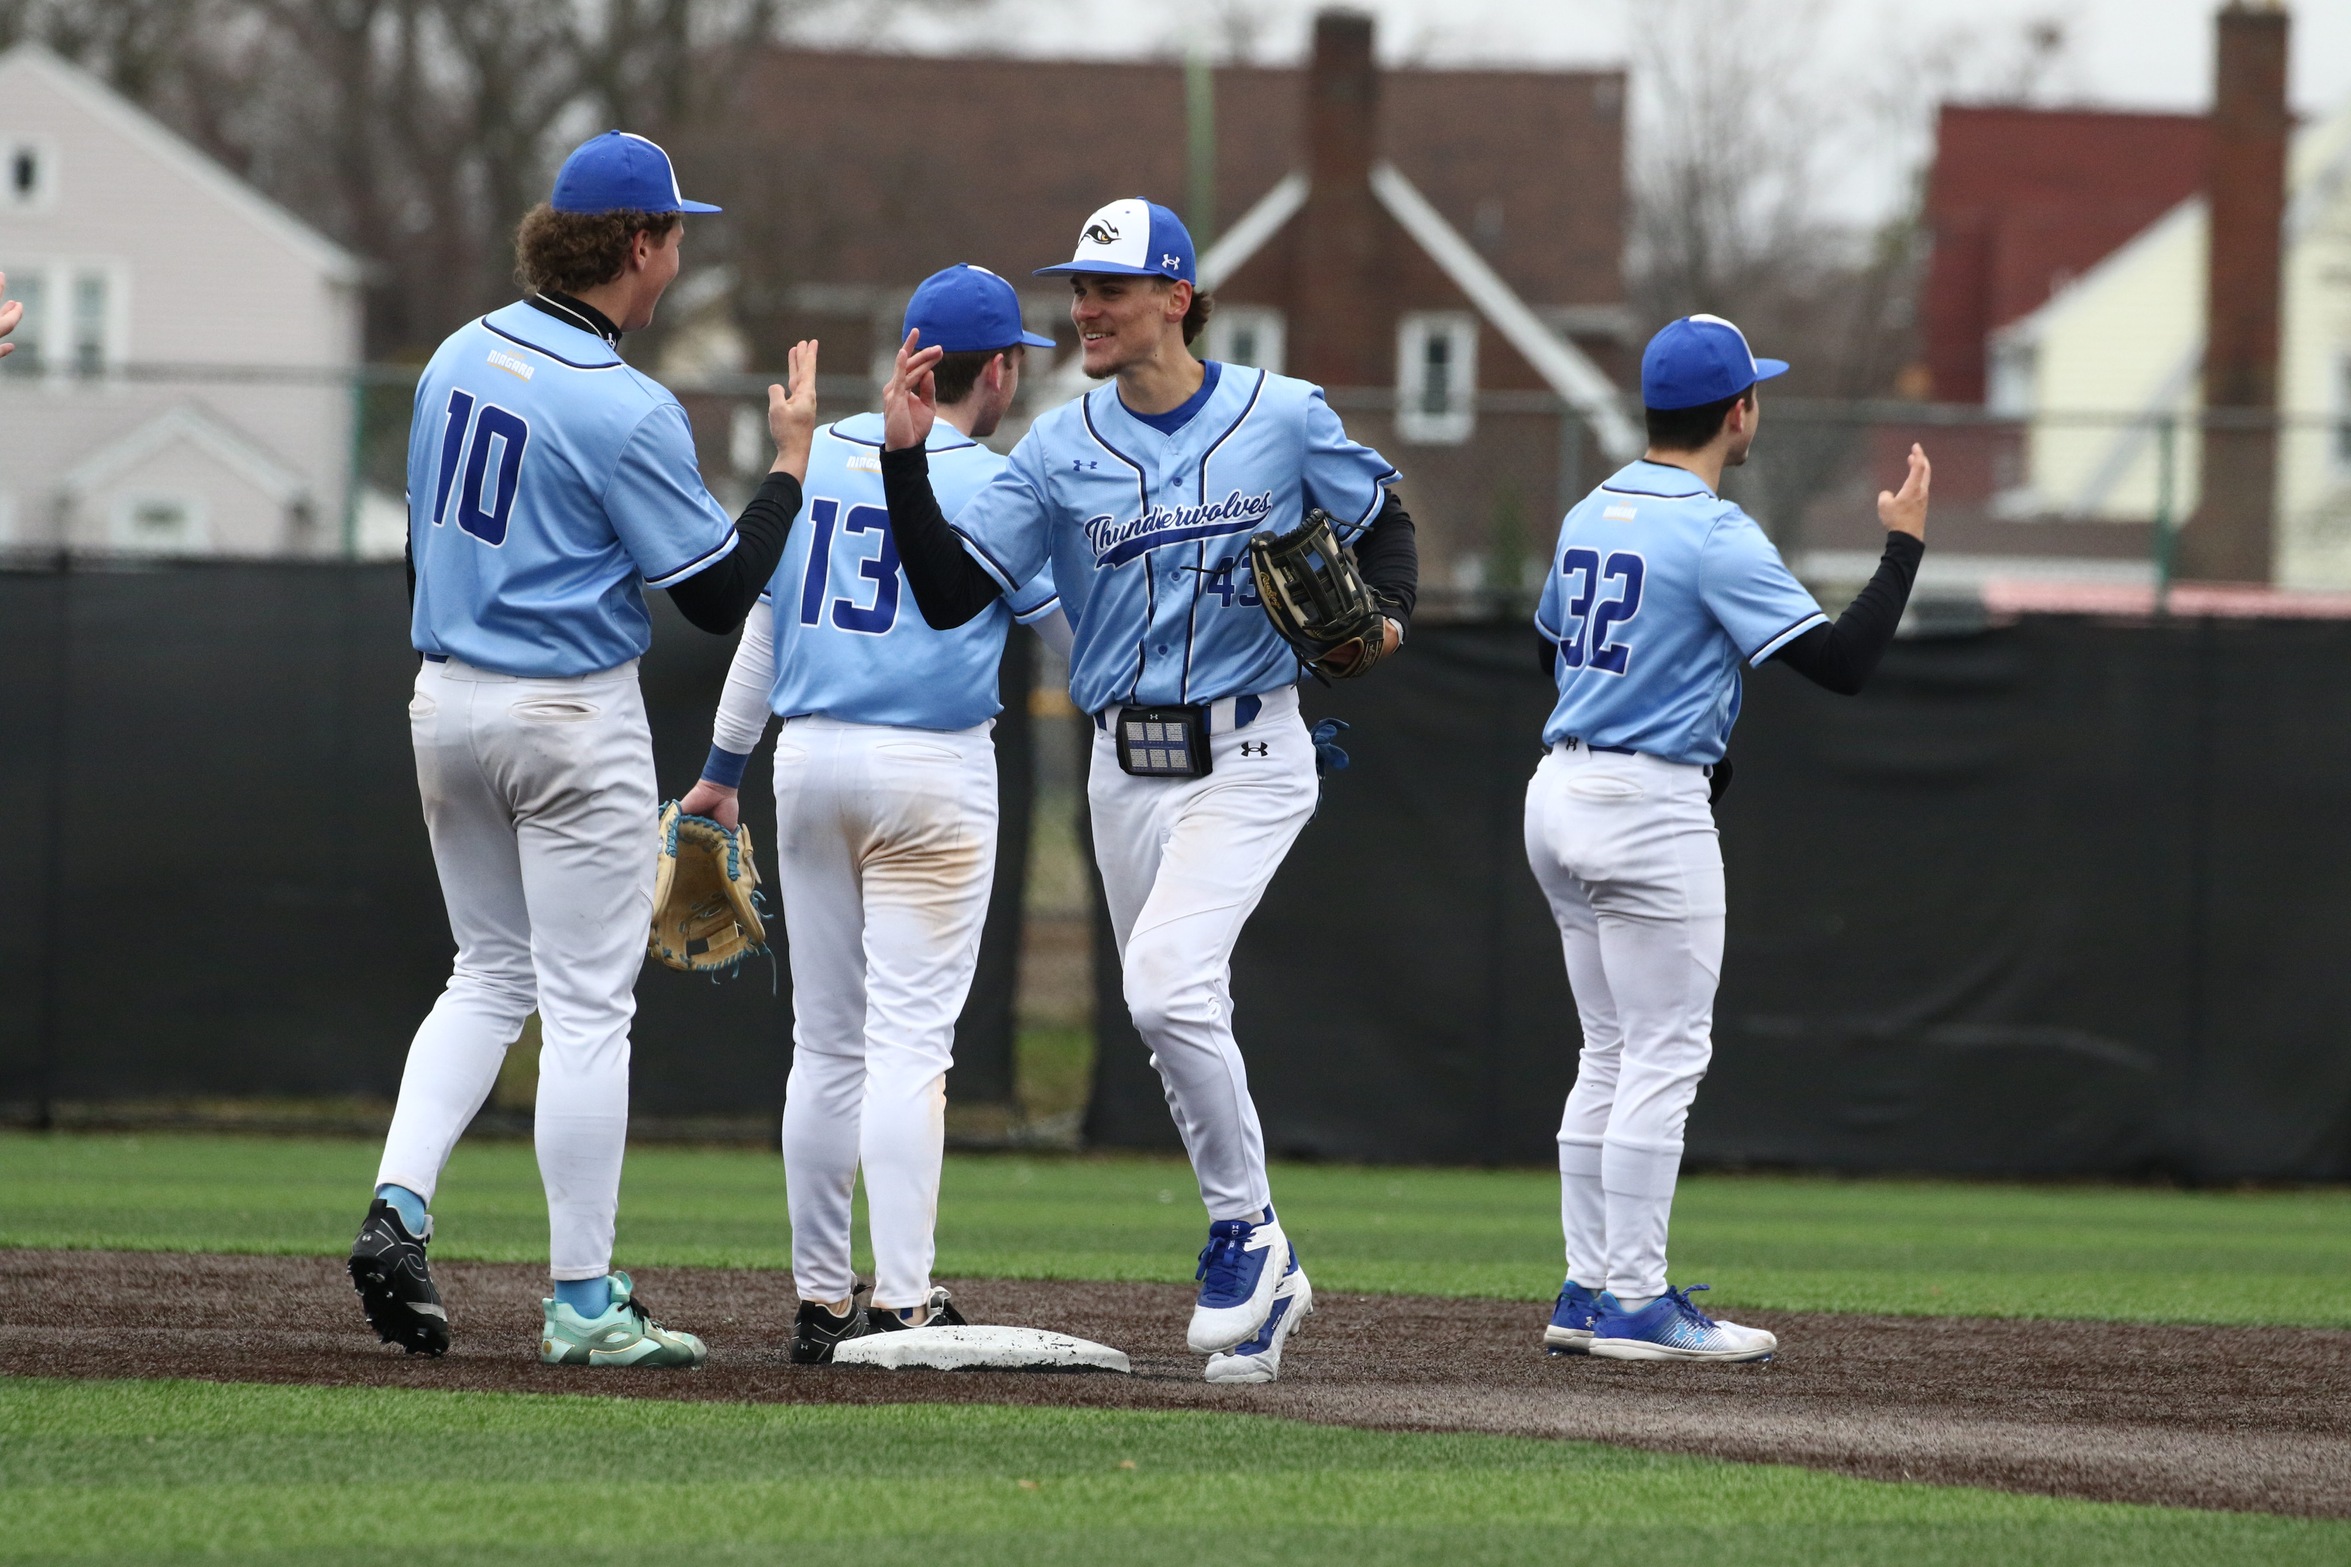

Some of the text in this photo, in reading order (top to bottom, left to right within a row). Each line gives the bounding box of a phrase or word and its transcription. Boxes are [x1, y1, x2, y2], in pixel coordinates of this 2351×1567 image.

[433, 386, 530, 548] 10
[846, 455, 882, 470] NIAGA
[1084, 488, 1272, 562] Thunderwolves
[800, 496, 901, 637] 13
[1559, 545, 1647, 677] 32
